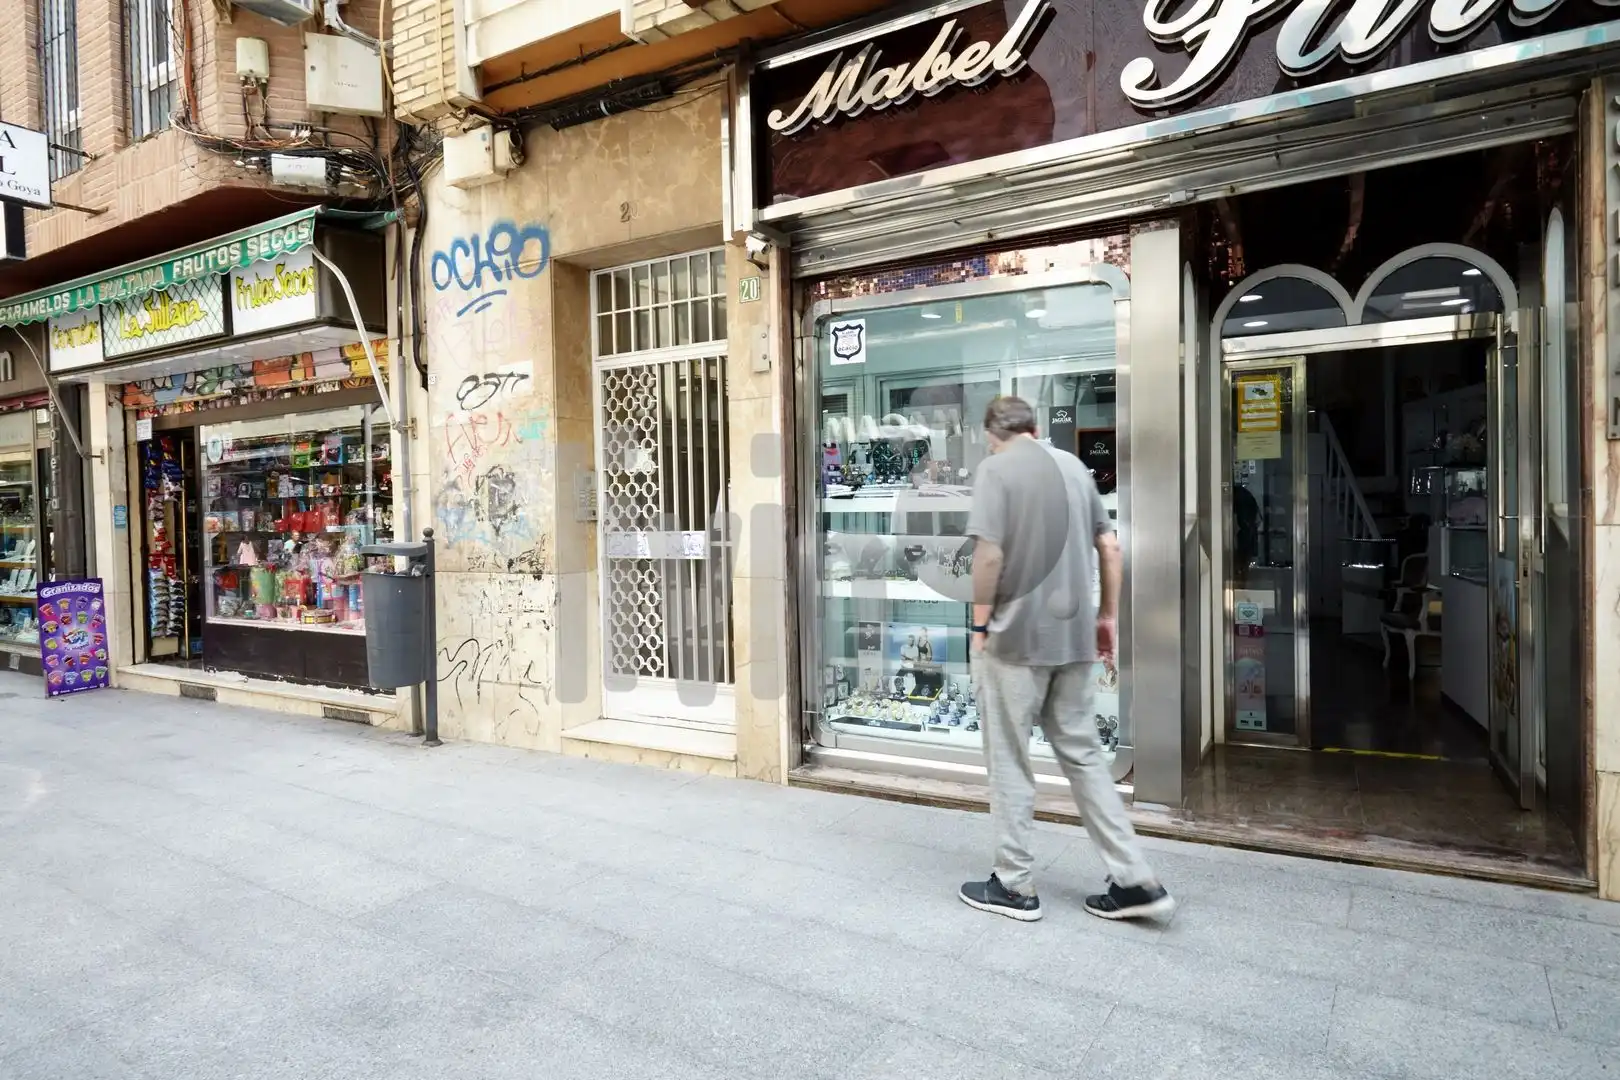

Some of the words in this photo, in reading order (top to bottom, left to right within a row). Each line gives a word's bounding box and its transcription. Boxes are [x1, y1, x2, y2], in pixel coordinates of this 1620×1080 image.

[766, 0, 1048, 131] Mabel
[7, 179, 41, 197] Goya
[0, 292, 71, 321] CARAMELOS
[76, 287, 95, 307] LA
[172, 241, 241, 279] FRUTOS
[246, 218, 312, 258] SECOS
[741, 279, 757, 300] 20
[118, 303, 143, 339] La
[40, 583, 101, 599] Granizados
